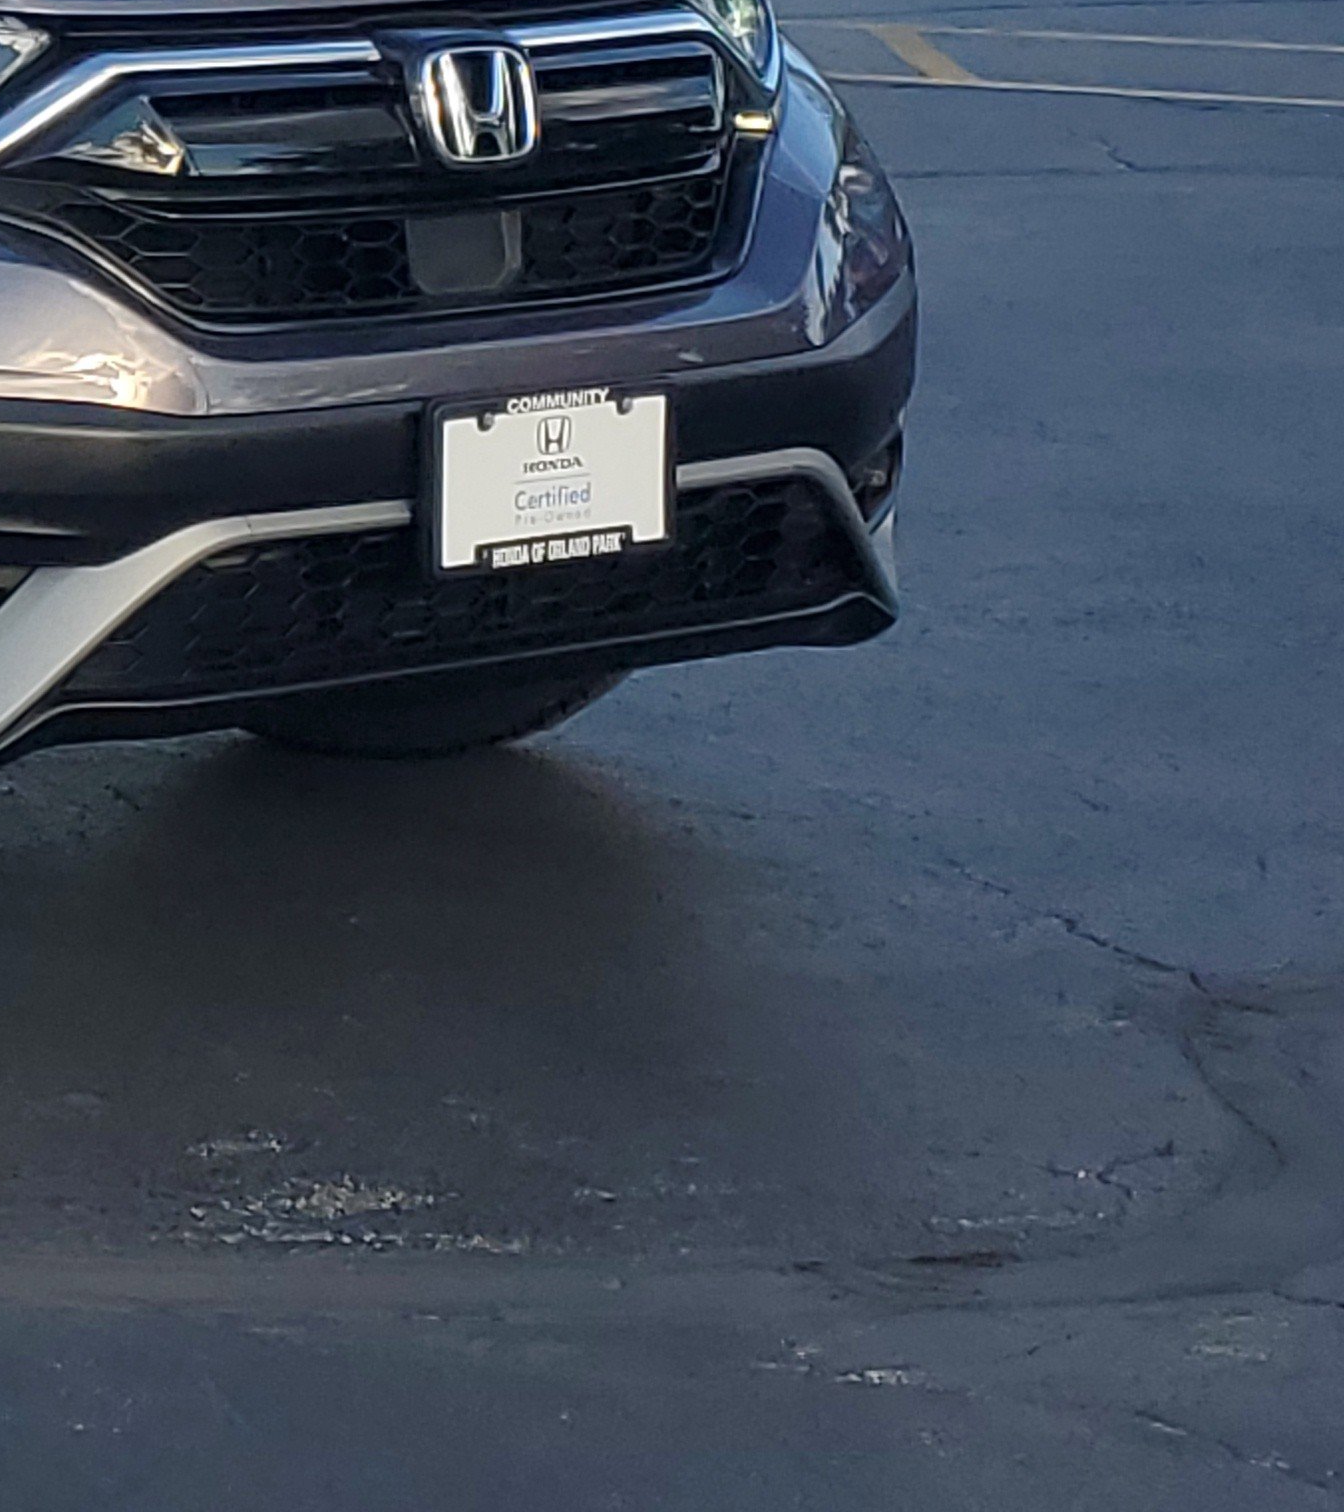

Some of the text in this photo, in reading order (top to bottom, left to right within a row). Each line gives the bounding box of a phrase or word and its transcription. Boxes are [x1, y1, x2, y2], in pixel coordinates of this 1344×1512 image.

[506, 388, 610, 413] COMMUNITY
[523, 456, 583, 474] HONDA
[514, 483, 592, 510] Certified
